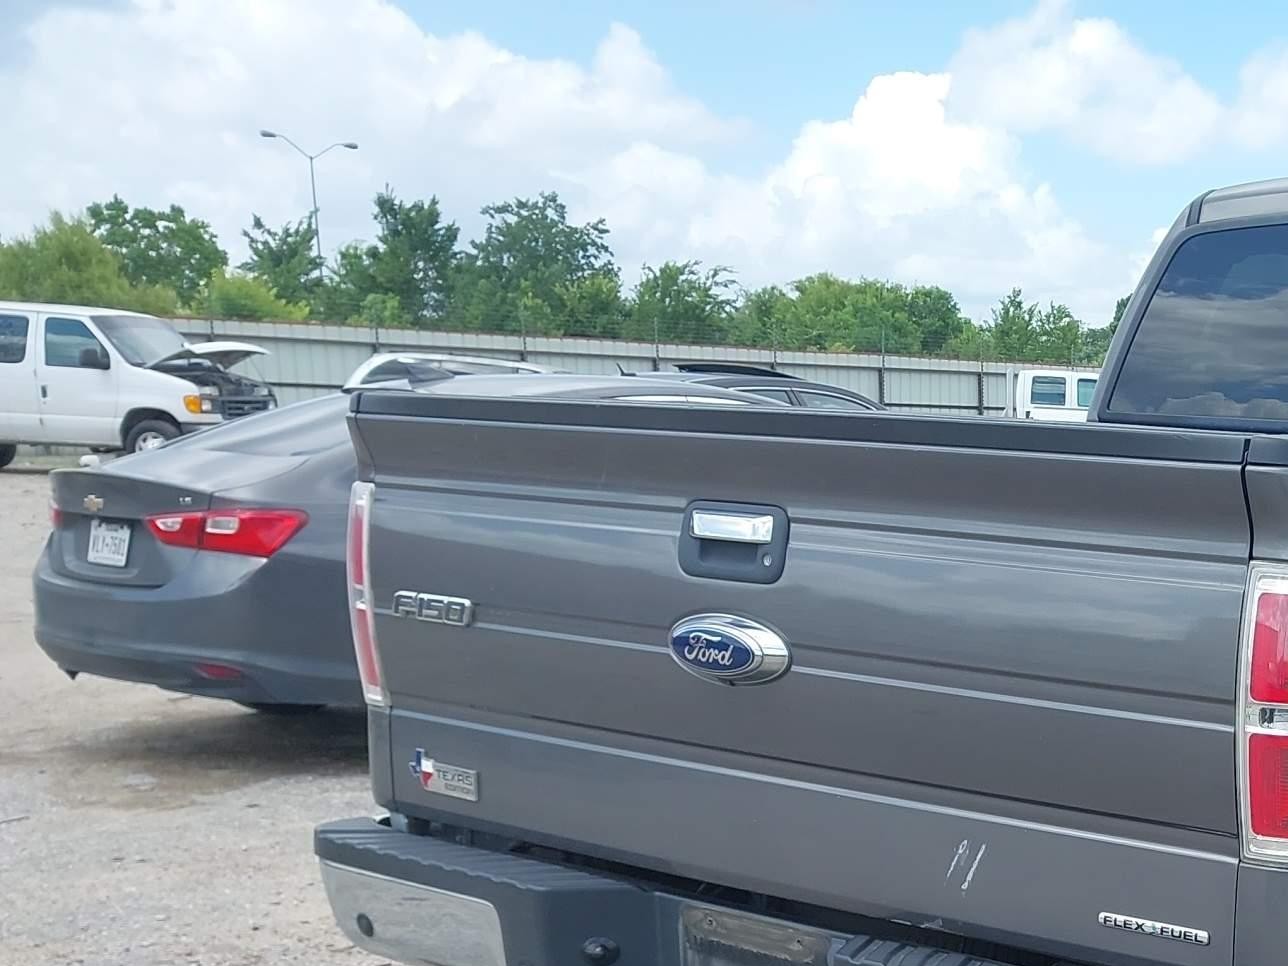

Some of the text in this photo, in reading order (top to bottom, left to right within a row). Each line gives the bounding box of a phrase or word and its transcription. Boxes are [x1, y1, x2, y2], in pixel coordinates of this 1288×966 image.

[684, 631, 734, 666] Ford
[436, 768, 473, 786] TEXAS
[1103, 915, 1205, 944] FLEX FUEL
